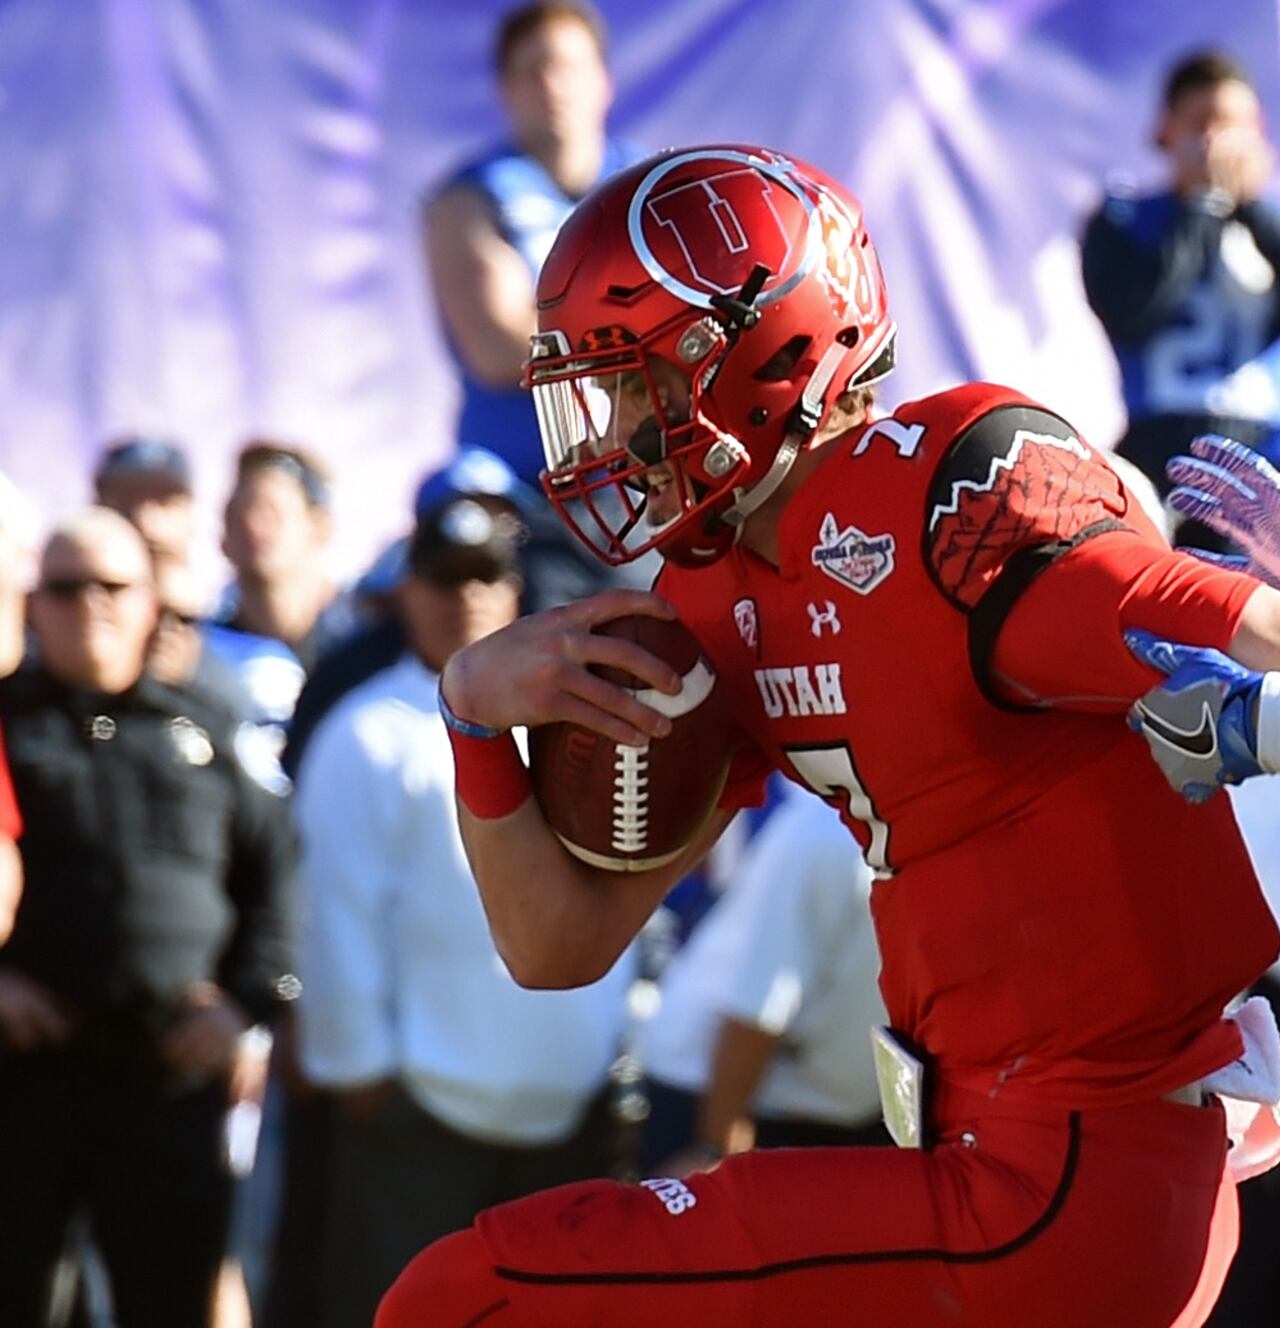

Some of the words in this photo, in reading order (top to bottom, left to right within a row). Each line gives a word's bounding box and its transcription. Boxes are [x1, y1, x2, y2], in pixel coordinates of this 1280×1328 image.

[646, 167, 793, 296] U
[754, 663, 847, 718] UTAH
[781, 740, 900, 881] 7
